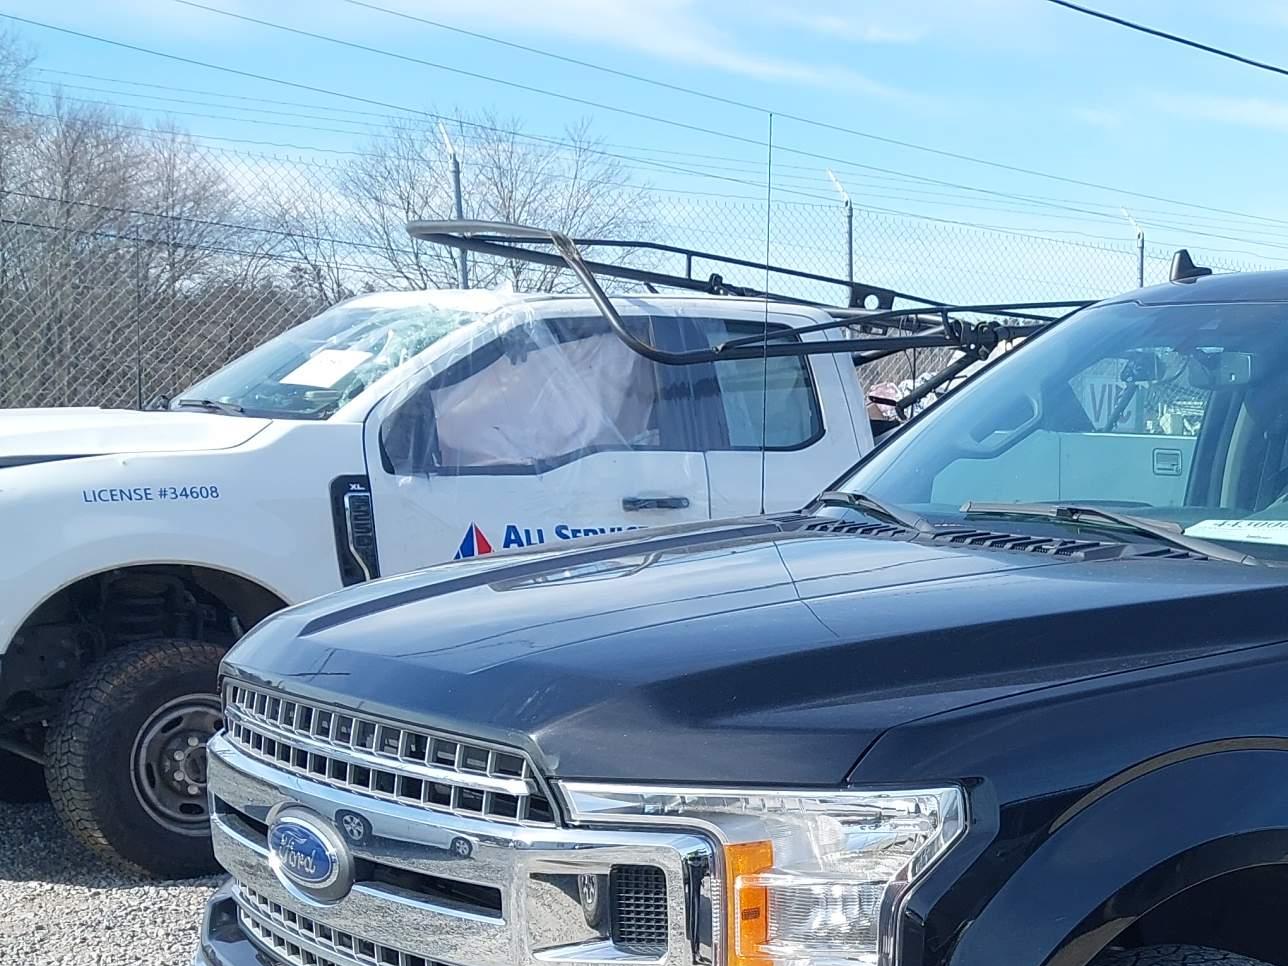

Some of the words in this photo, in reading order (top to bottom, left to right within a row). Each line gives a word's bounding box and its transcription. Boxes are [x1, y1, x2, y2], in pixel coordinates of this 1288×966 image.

[82, 487, 154, 502] LICENSE
[158, 485, 220, 500] #34608
[279, 830, 317, 875] Ford
